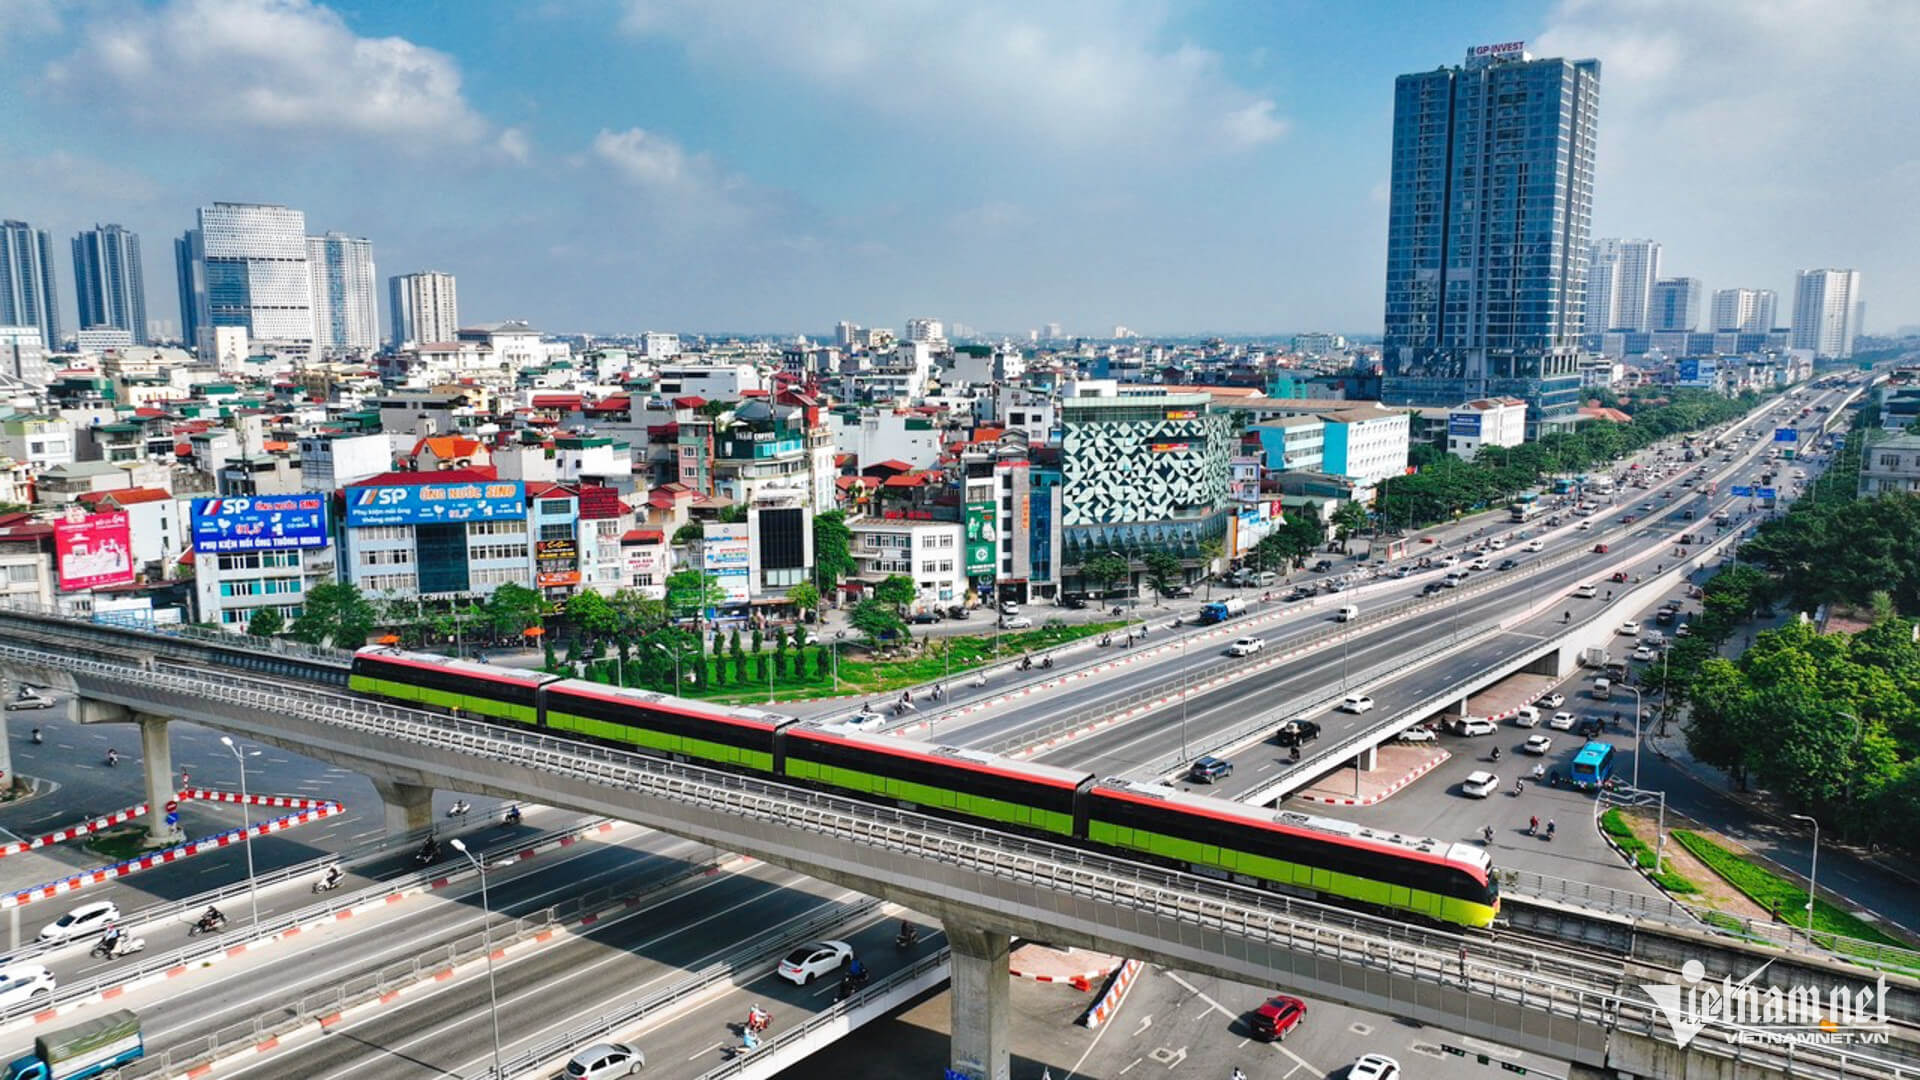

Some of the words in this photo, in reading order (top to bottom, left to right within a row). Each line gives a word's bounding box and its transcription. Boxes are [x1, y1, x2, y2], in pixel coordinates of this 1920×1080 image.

[378, 488, 408, 504] SP
[485, 484, 516, 498] SINO
[222, 499, 250, 514] SP
